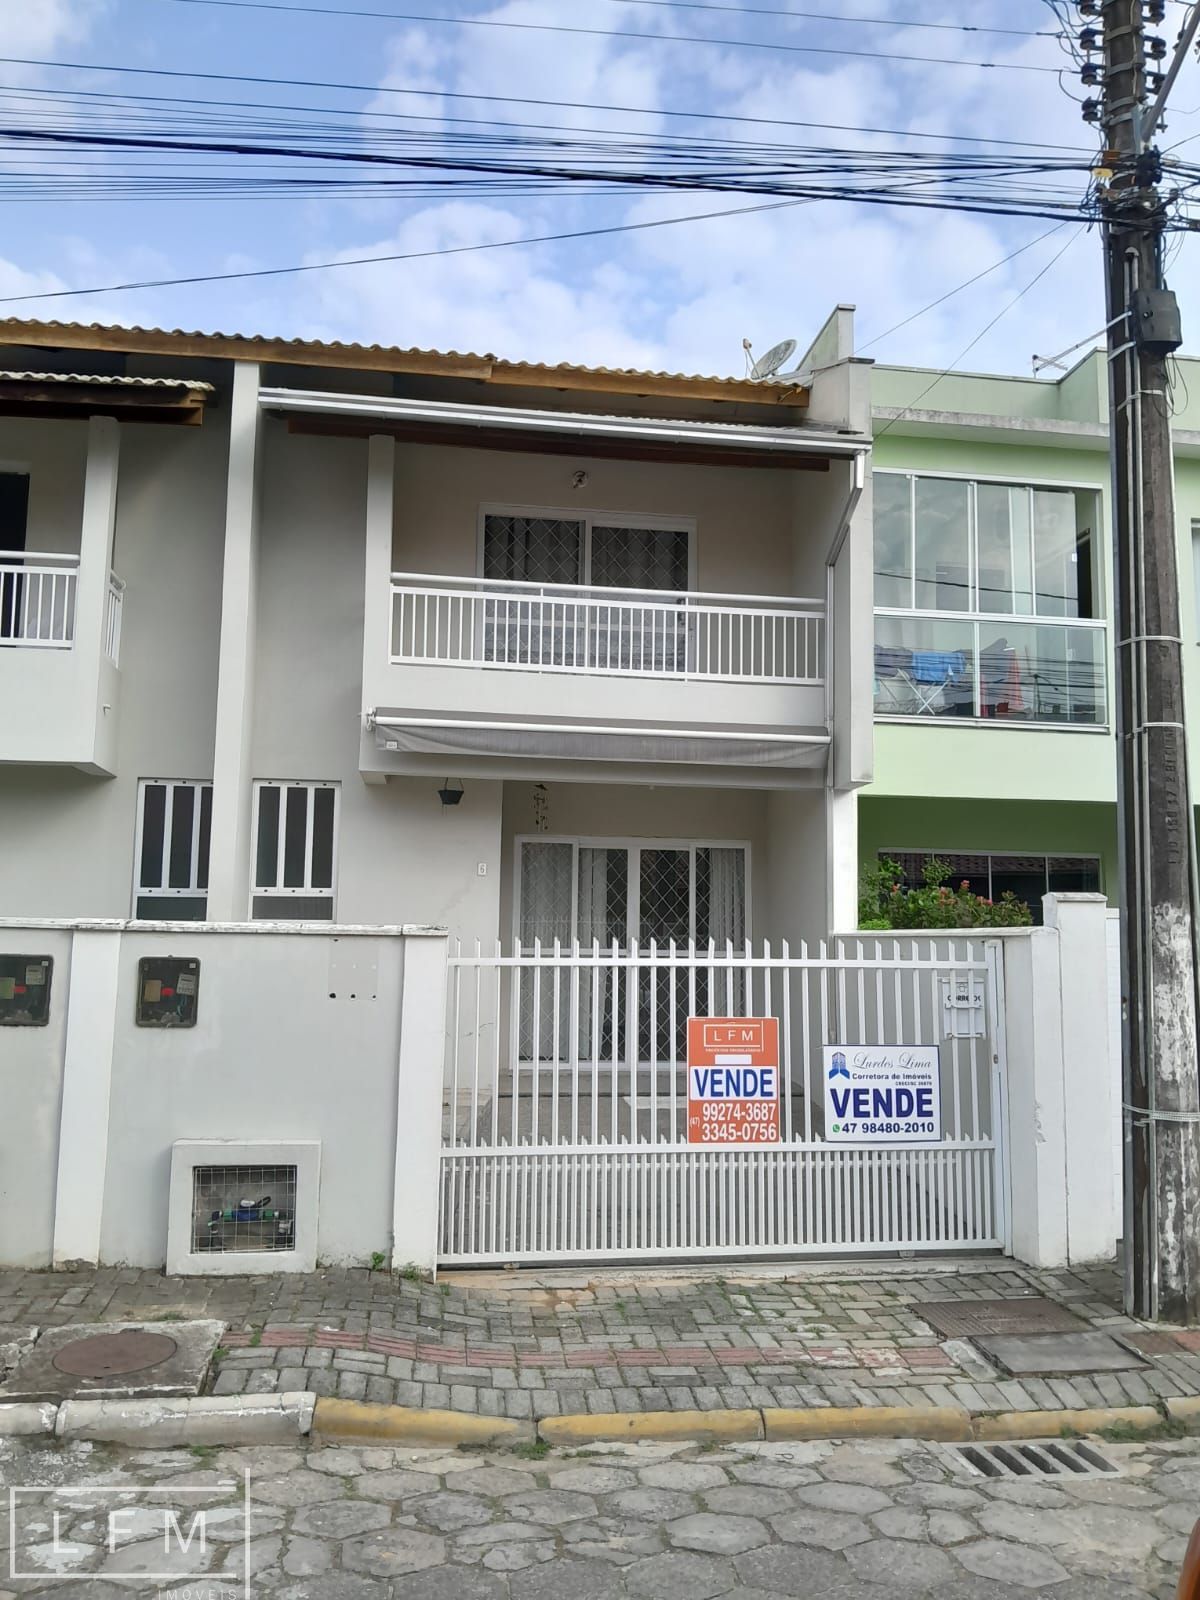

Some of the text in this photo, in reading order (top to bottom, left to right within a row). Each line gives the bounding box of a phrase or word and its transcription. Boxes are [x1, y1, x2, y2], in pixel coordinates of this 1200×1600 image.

[897, 1051, 932, 1070] Lima
[694, 1069, 774, 1097] VENDE
[891, 1072, 901, 1080] de
[702, 1103, 776, 1121] 99274-3687
[830, 1088, 934, 1118] VENDE
[690, 1117, 700, 1129] (47)
[702, 1123, 776, 1141] 3345-0756
[842, 1122, 935, 1134] 47 98480-2010
